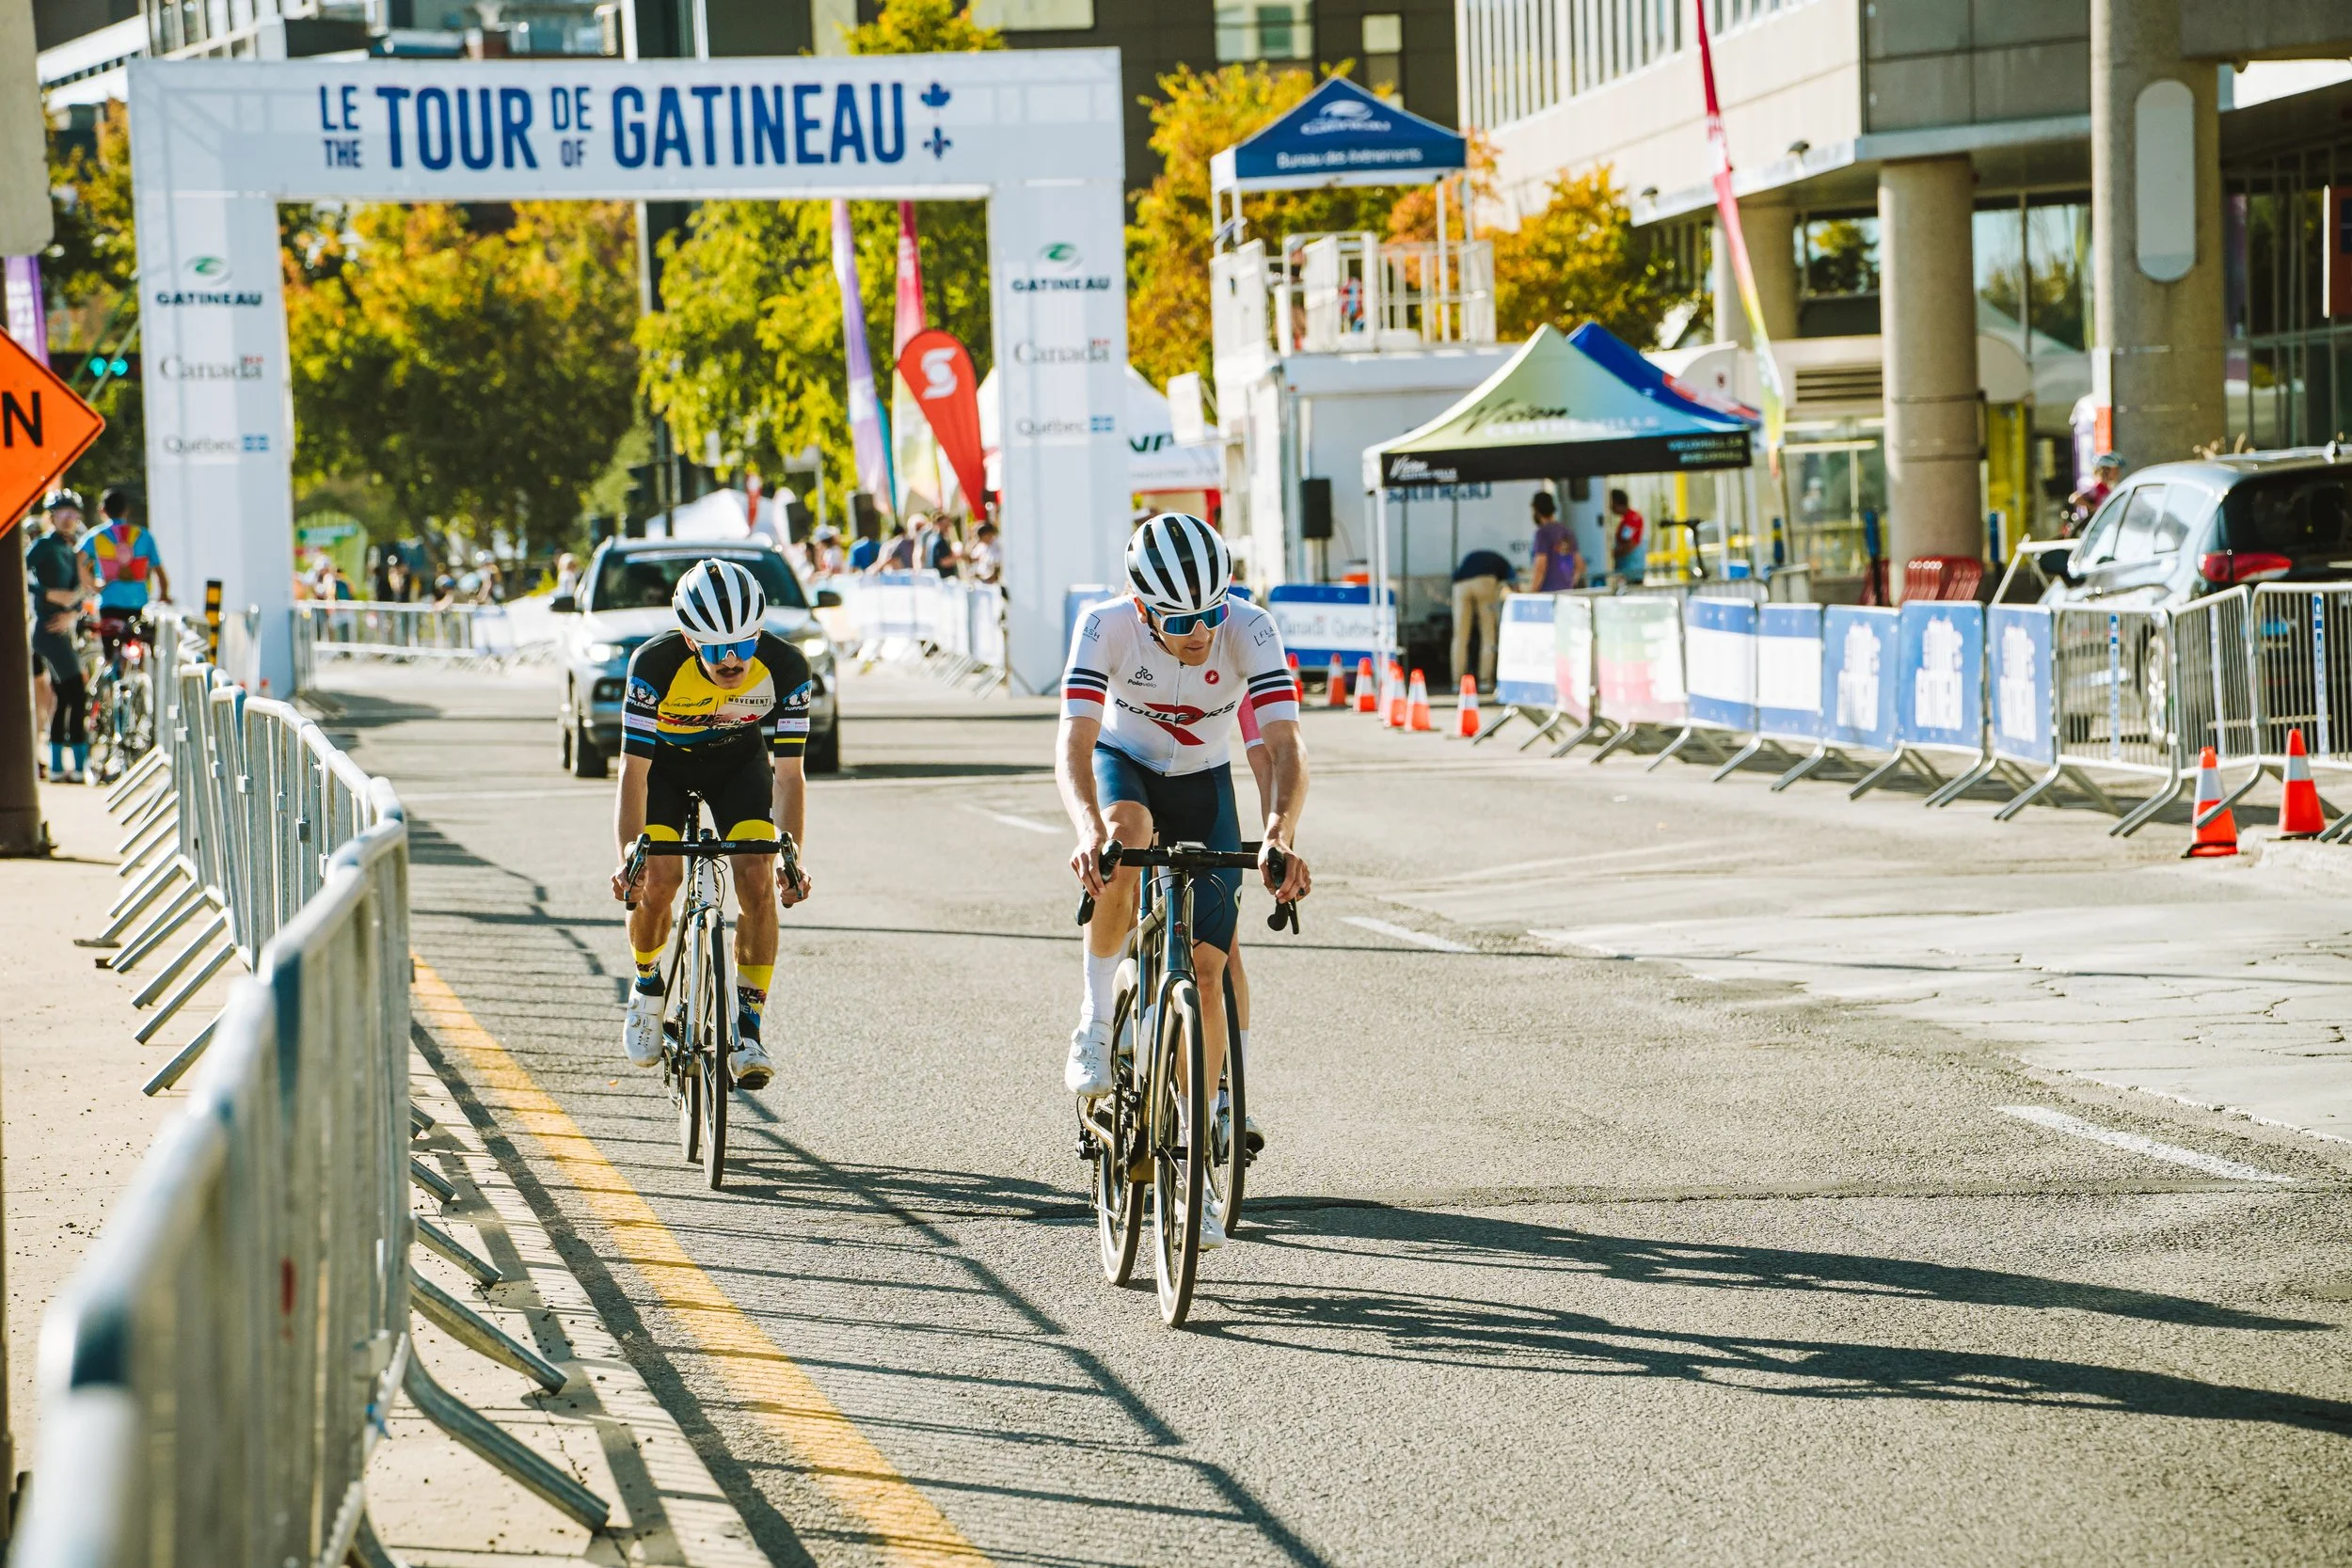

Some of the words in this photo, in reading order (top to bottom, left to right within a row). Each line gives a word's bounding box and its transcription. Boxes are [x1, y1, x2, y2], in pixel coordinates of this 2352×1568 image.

[320, 85, 359, 130] LE
[376, 87, 538, 170] TOUR
[551, 87, 592, 130] DE
[612, 82, 905, 168] GATINEAU
[324, 139, 362, 167] THE
[561, 139, 585, 167] OF
[1012, 278, 1110, 291] GATINEAU
[156, 292, 262, 306] GATINEAU
[1013, 340, 1110, 365] Canada
[159, 354, 262, 380] Canada
[727, 697, 770, 705] MOVEMENT
[1115, 698, 1236, 724] ROULEURS
